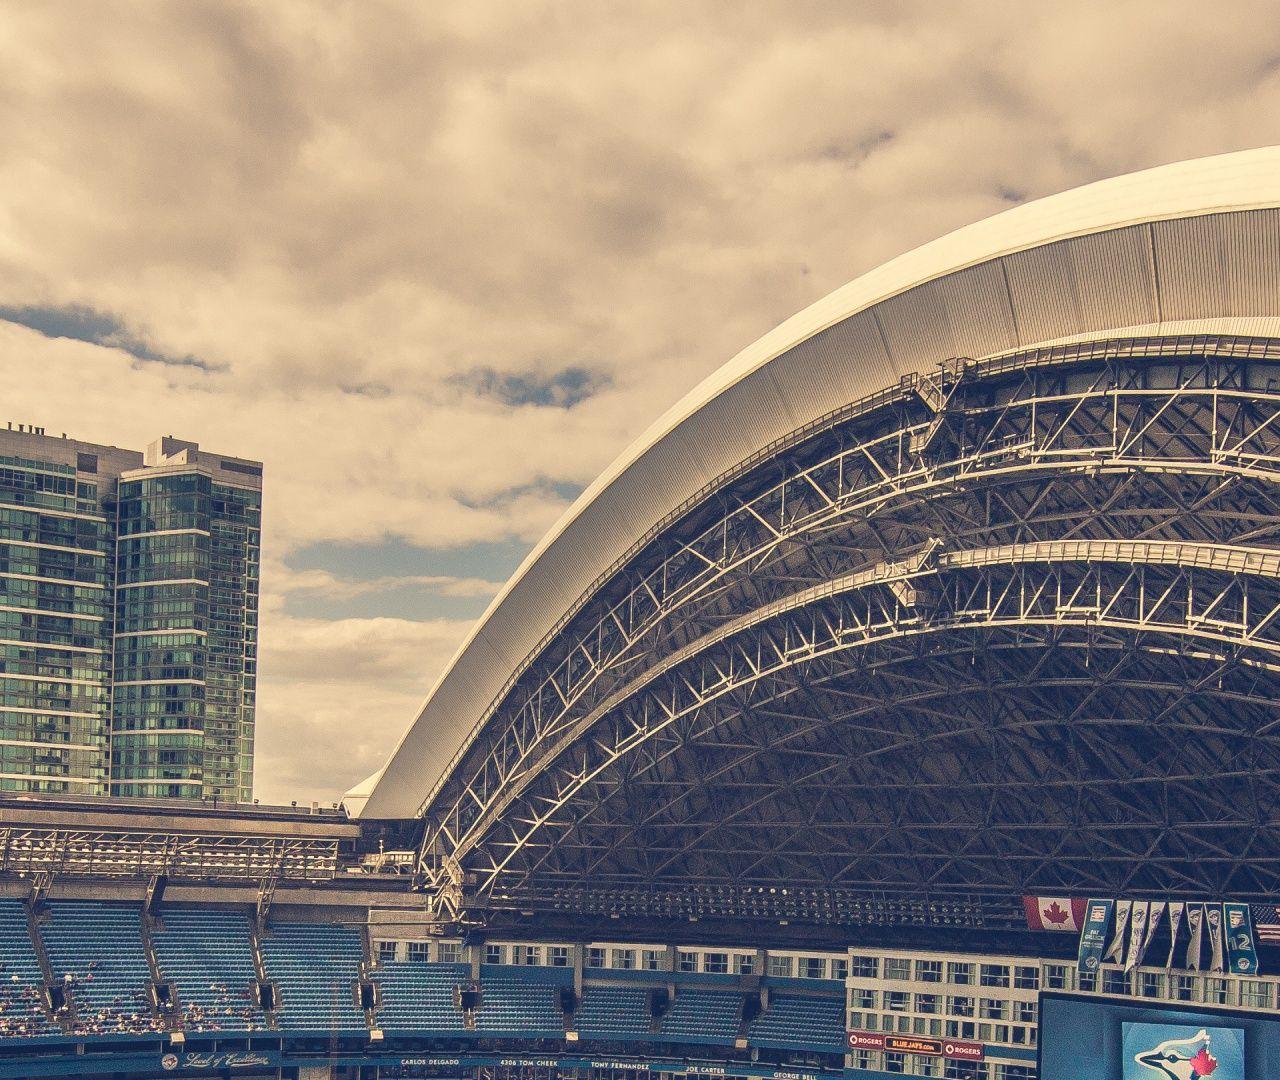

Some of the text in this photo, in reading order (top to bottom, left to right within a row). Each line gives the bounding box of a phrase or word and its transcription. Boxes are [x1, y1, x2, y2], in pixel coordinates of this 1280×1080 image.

[1231, 933, 1252, 950] 12
[858, 1037, 882, 1046] ROGERS
[955, 1047, 981, 1055] ROGERS
[611, 1062, 650, 1070] FERNANDEZ
[773, 1072, 800, 1080] GEORGE
